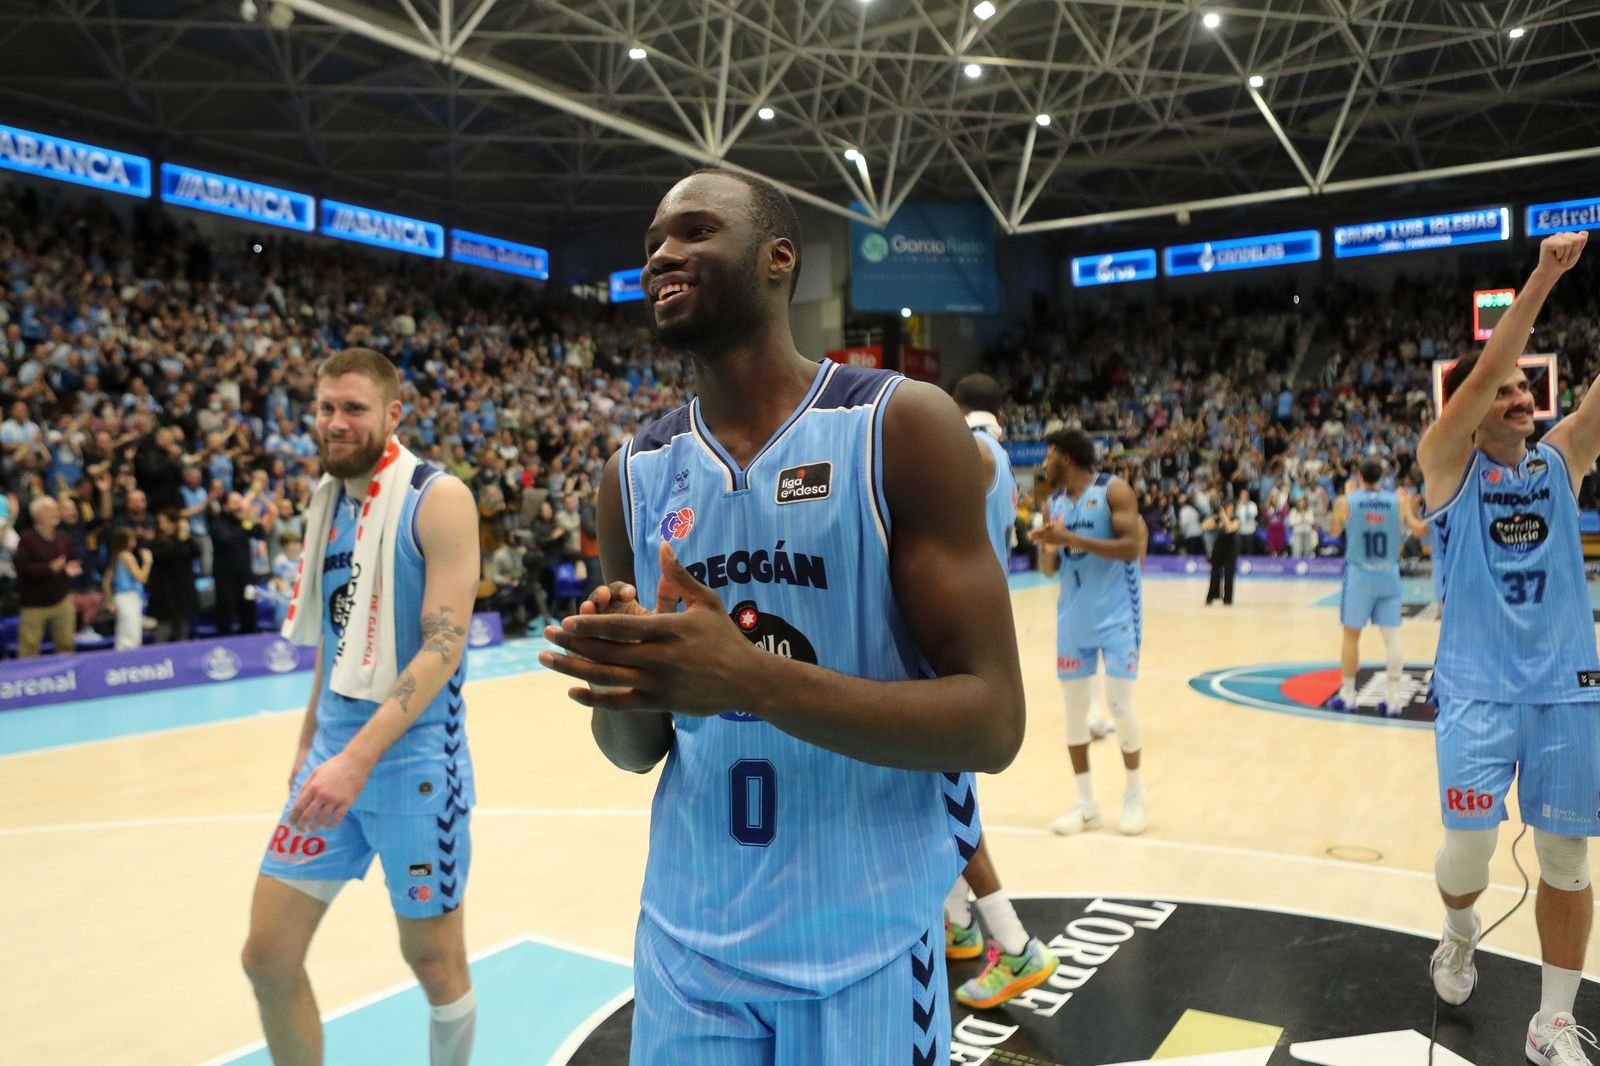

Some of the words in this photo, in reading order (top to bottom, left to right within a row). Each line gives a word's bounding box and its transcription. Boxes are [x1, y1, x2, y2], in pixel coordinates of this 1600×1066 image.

[0, 131, 131, 187] ABANCA
[175, 170, 297, 222] ABANCA
[332, 208, 430, 248] ABANCA
[1335, 224, 1386, 245] GRUPO
[1391, 219, 1424, 239] LUIS
[1429, 211, 1498, 234] IGLESIAS
[780, 484, 827, 498] endesa
[781, 477, 803, 490] liga
[1363, 532, 1388, 559] 10
[1074, 569, 1082, 588] 1
[1502, 570, 1547, 605] 37
[362, 616, 377, 667] GALICIA
[0, 669, 78, 698] arenal
[105, 658, 175, 686] arenal
[728, 758, 778, 847] 0
[1008, 897, 1178, 1017] TORRE
